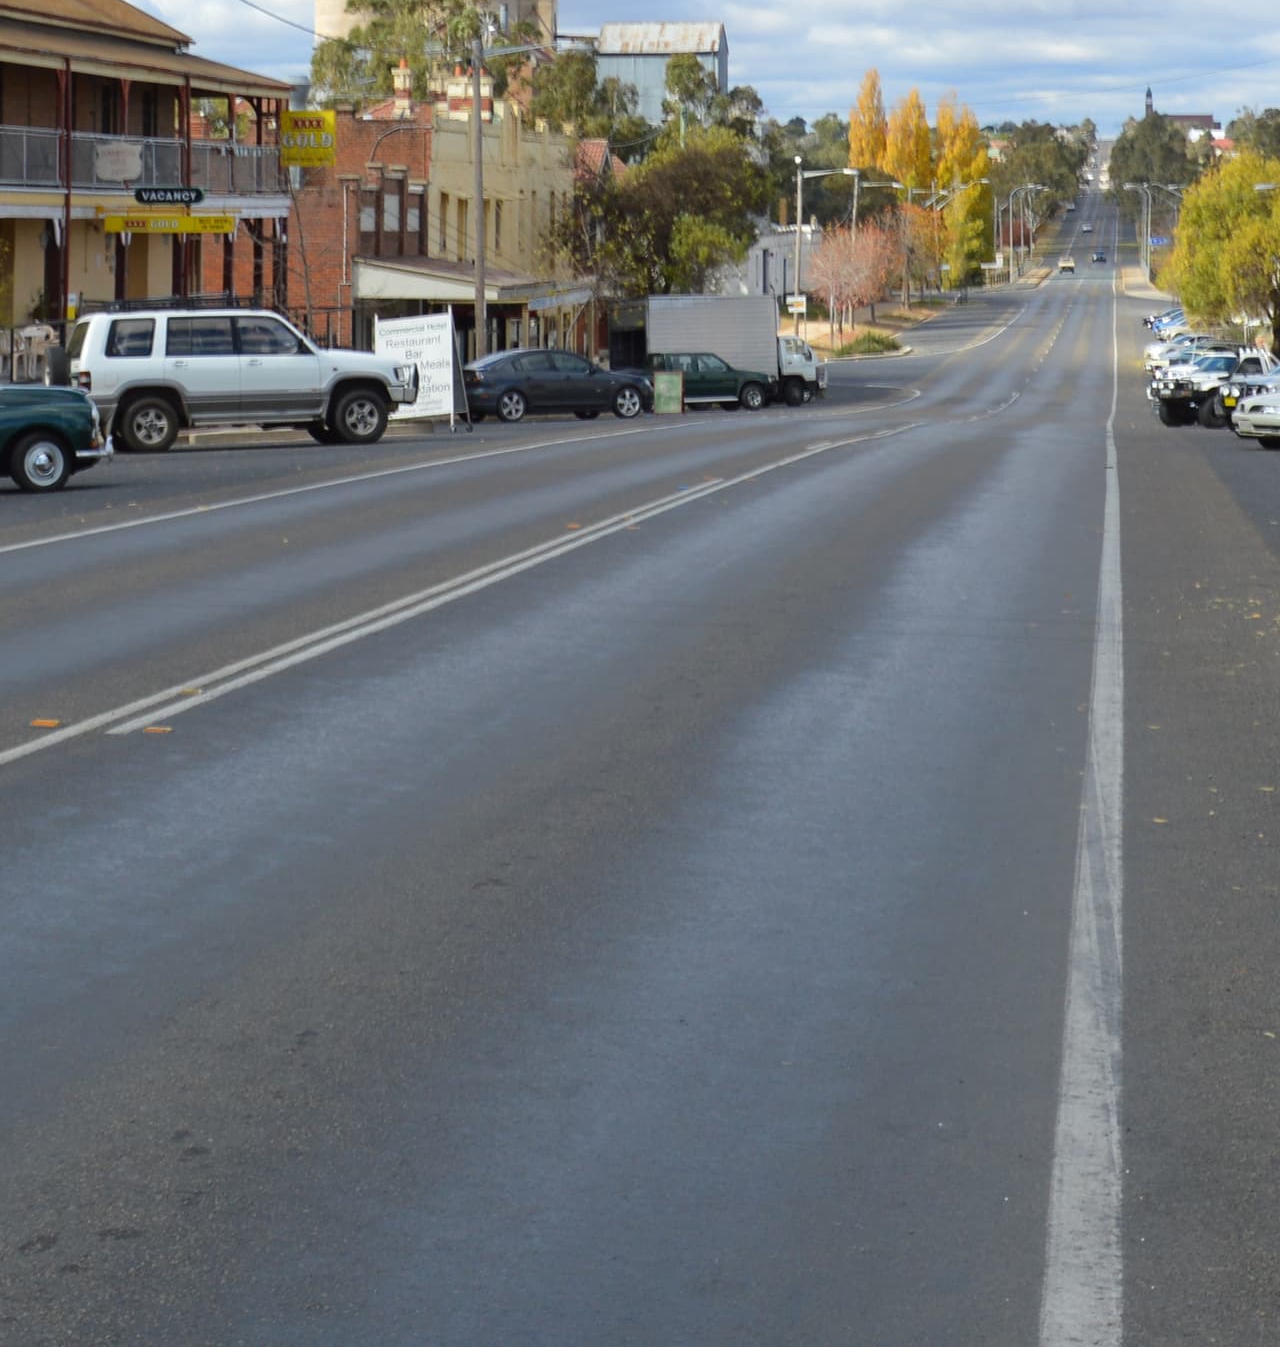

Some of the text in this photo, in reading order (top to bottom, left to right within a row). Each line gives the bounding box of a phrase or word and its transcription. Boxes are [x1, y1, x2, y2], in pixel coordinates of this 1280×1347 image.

[292, 117, 324, 130] XXXX
[283, 132, 333, 149] GOLD
[142, 191, 197, 202] VACANCY
[150, 219, 179, 229] GOLD
[385, 335, 441, 350] Restaurant
[405, 349, 423, 361] Bar
[420, 358, 450, 370] Meals
